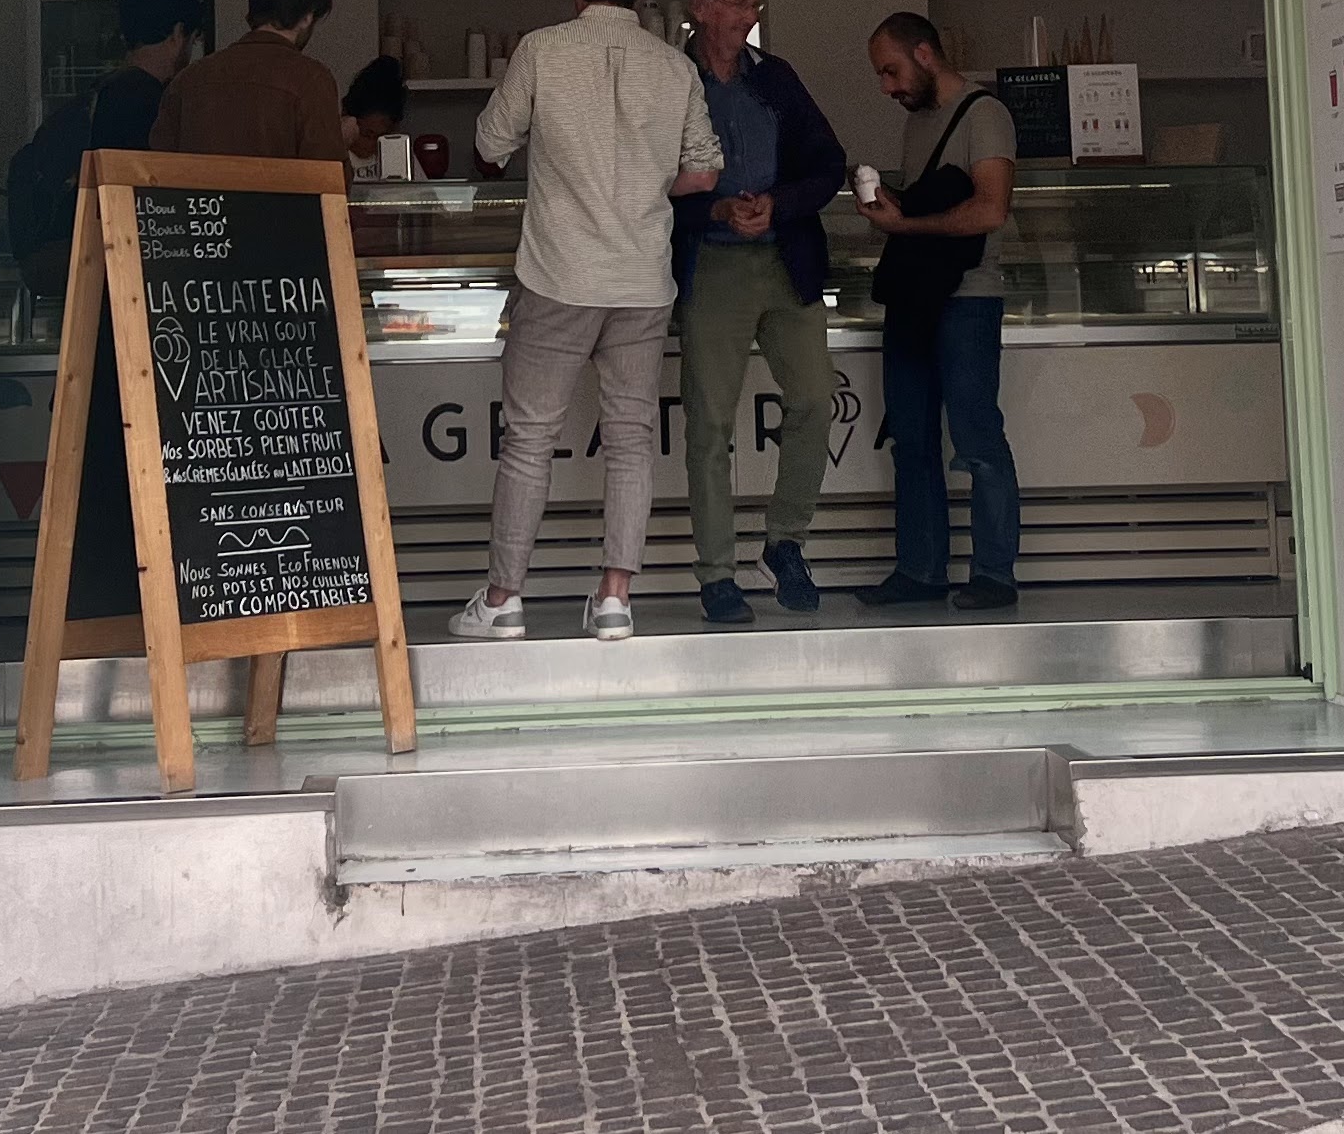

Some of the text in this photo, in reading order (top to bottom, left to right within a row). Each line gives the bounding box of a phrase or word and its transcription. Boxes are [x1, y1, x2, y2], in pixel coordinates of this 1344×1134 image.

[147, 277, 329, 314] LA GELATERIA
[197, 321, 218, 344] LE
[226, 319, 269, 343] VRAI
[200, 346, 318, 371] DE LA GLACE
[195, 365, 340, 403] ARTISANALE
[181, 405, 327, 435] VENEZ GOÛTER
[187, 436, 254, 459] SORBETS
[260, 433, 299, 455] PLEIN
[302, 430, 343, 453] FRUIT
[286, 457, 312, 477] LAIT
[199, 497, 345, 522] SANS CONSERVATEUR
[191, 583, 215, 599] NOS
[223, 579, 256, 596] POTS
[260, 576, 274, 593] ET
[282, 574, 309, 590] NOS
[199, 586, 368, 618] SONT COMPOSTABLES
